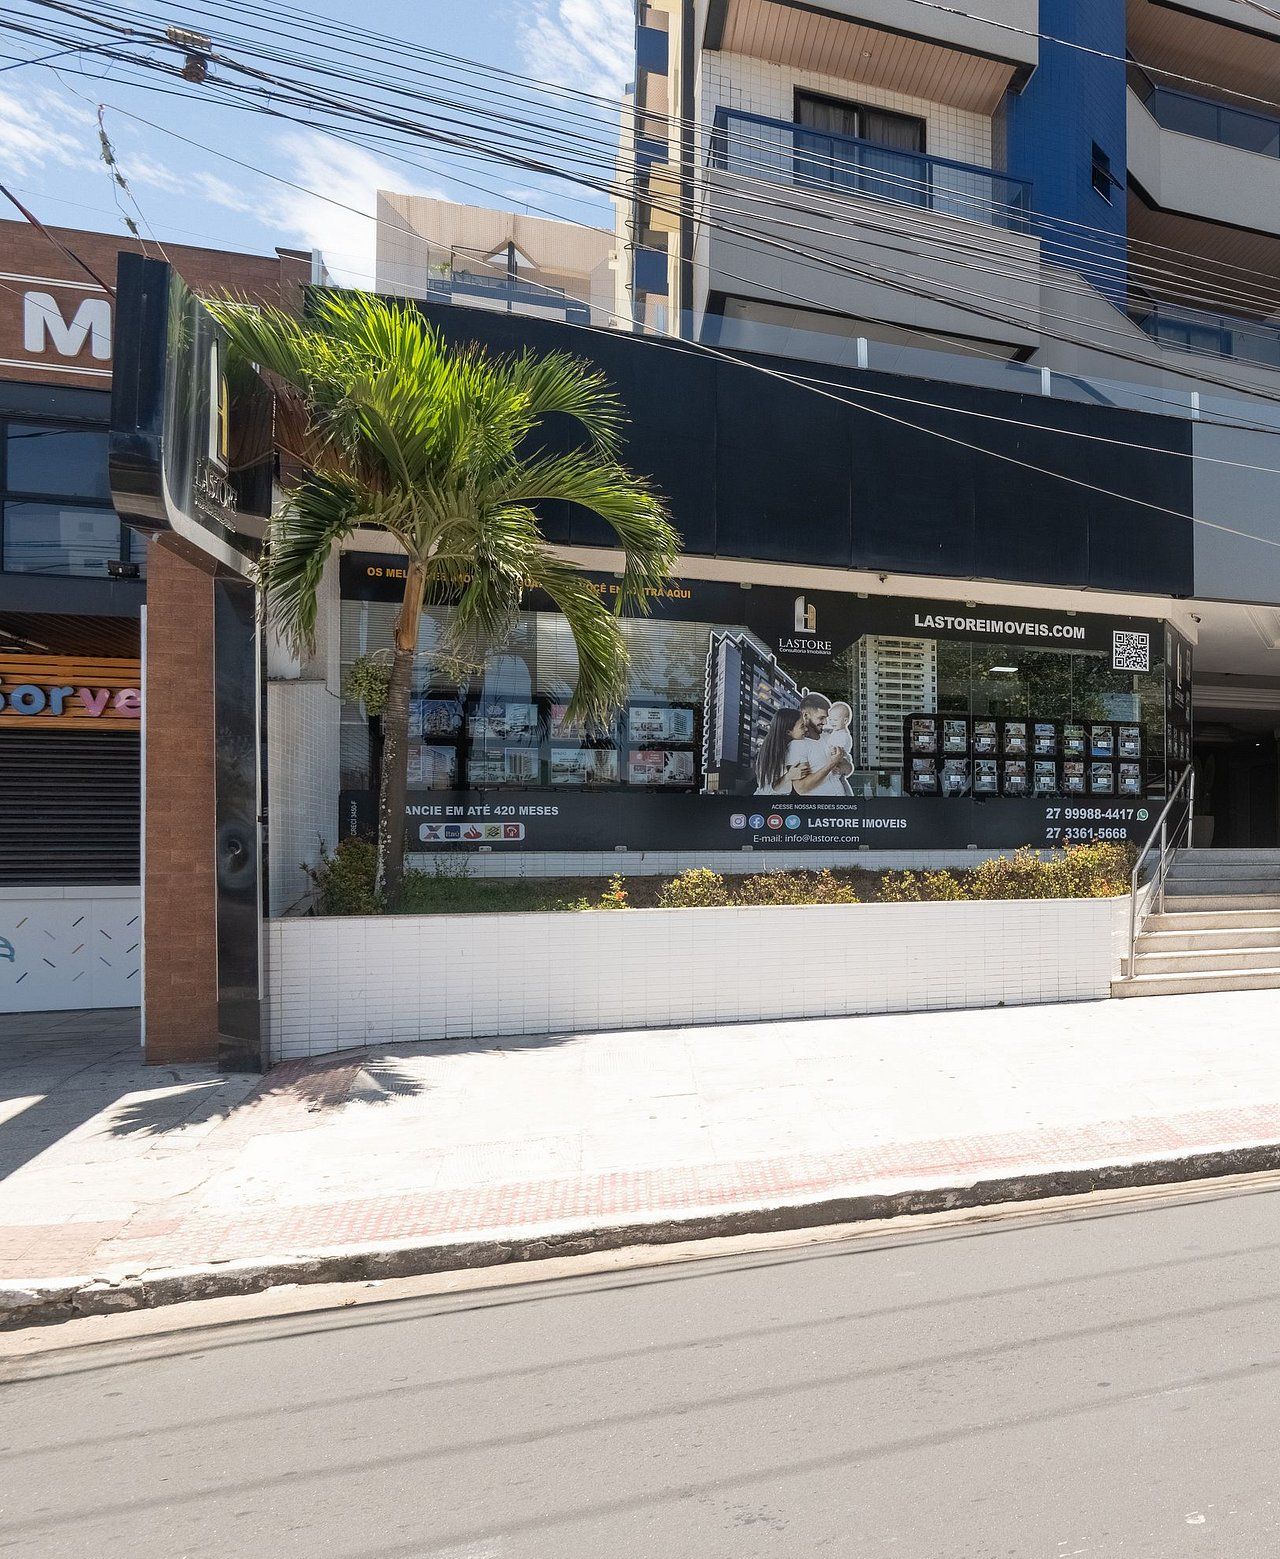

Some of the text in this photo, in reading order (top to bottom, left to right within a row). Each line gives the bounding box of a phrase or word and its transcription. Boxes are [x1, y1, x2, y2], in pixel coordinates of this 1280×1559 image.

[367, 567, 383, 577] OS
[666, 589, 691, 599] AQUI
[914, 614, 1085, 639] LASTOREIMOVEIS.COM
[779, 638, 832, 650] LASTORE
[0, 677, 141, 718] orve
[405, 804, 559, 816] ANCIE EM ATÉ 420 MESES
[1046, 808, 1134, 820] 27 99988-4417
[808, 818, 907, 829] LASTORE IMOVEIS
[753, 834, 860, 844] E-mail: info@lastore.com
[1046, 827, 1127, 839] 27 3361-5668
